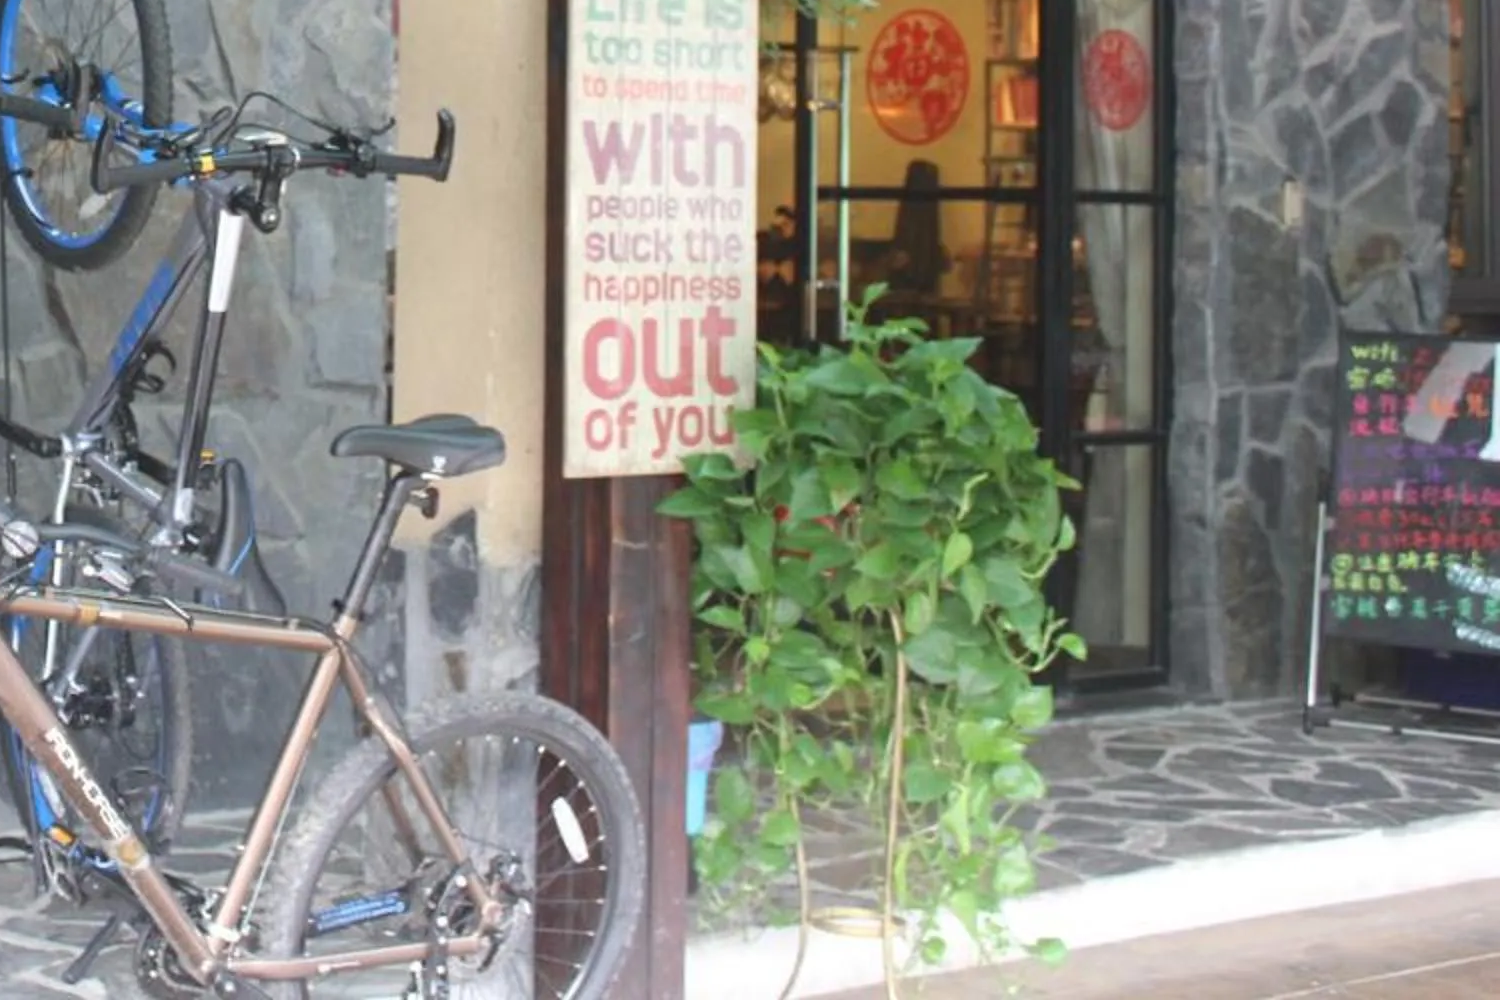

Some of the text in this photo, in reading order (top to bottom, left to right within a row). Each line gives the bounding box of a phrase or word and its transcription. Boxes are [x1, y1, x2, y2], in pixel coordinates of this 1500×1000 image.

[584, 30, 745, 72] too short
[582, 72, 608, 99] to
[615, 74, 689, 103] spend
[582, 112, 746, 188] with
[586, 194, 743, 223] people who
[584, 228, 744, 264] suck the
[584, 272, 743, 306] happiness
[583, 305, 740, 400] out
[584, 401, 737, 460] of you
